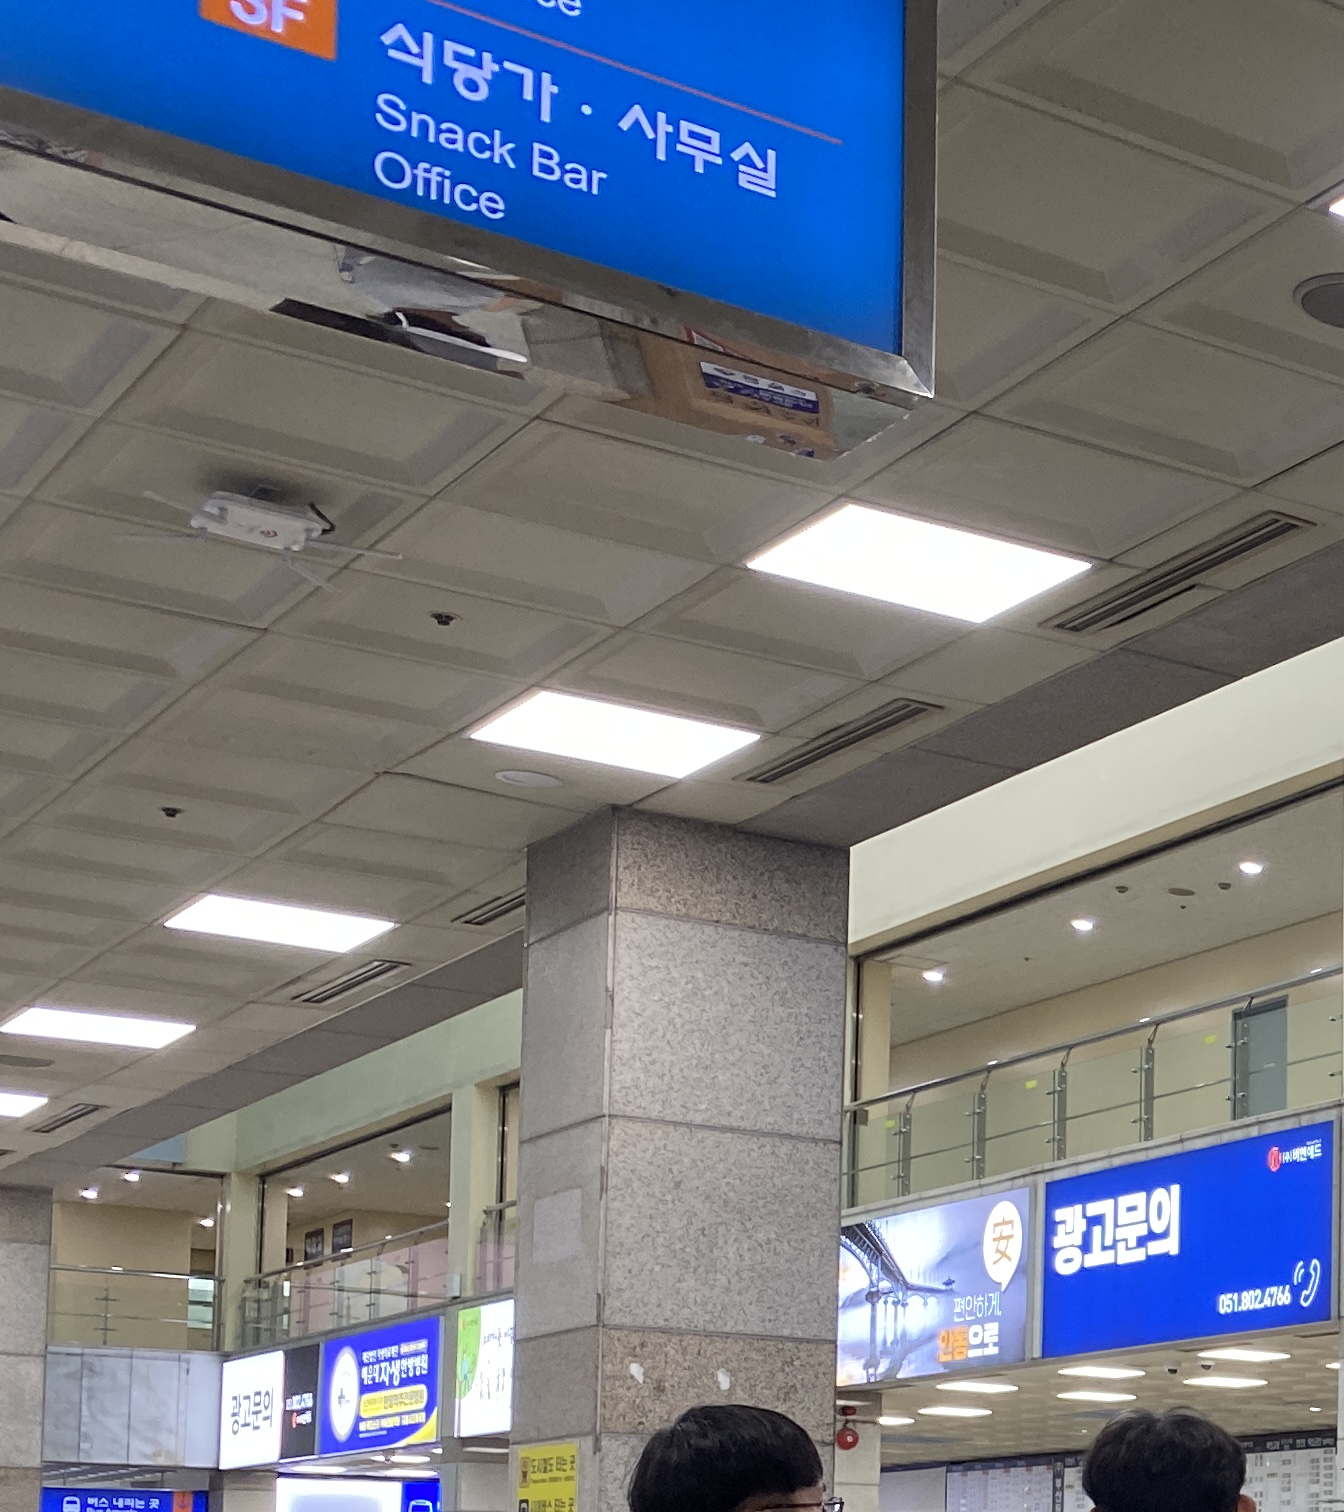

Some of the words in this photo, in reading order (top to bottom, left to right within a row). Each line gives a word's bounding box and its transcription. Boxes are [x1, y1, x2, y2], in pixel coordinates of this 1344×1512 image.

[380, 22, 558, 123] 식당가
[618, 103, 778, 199] 사무실
[374, 92, 516, 170] Snack
[531, 141, 608, 197] Bar
[374, 151, 506, 221] Office
[991, 1215, 1017, 1265] 安
[1053, 1184, 1180, 1276] 광고문의
[1218, 1285, 1291, 1316] 051.802.4766
[231, 1387, 274, 1436] 광고문의
[87, 1496, 108, 1508] 버스
[113, 1497, 145, 1509] 내리는
[149, 1498, 160, 1510] 곳
